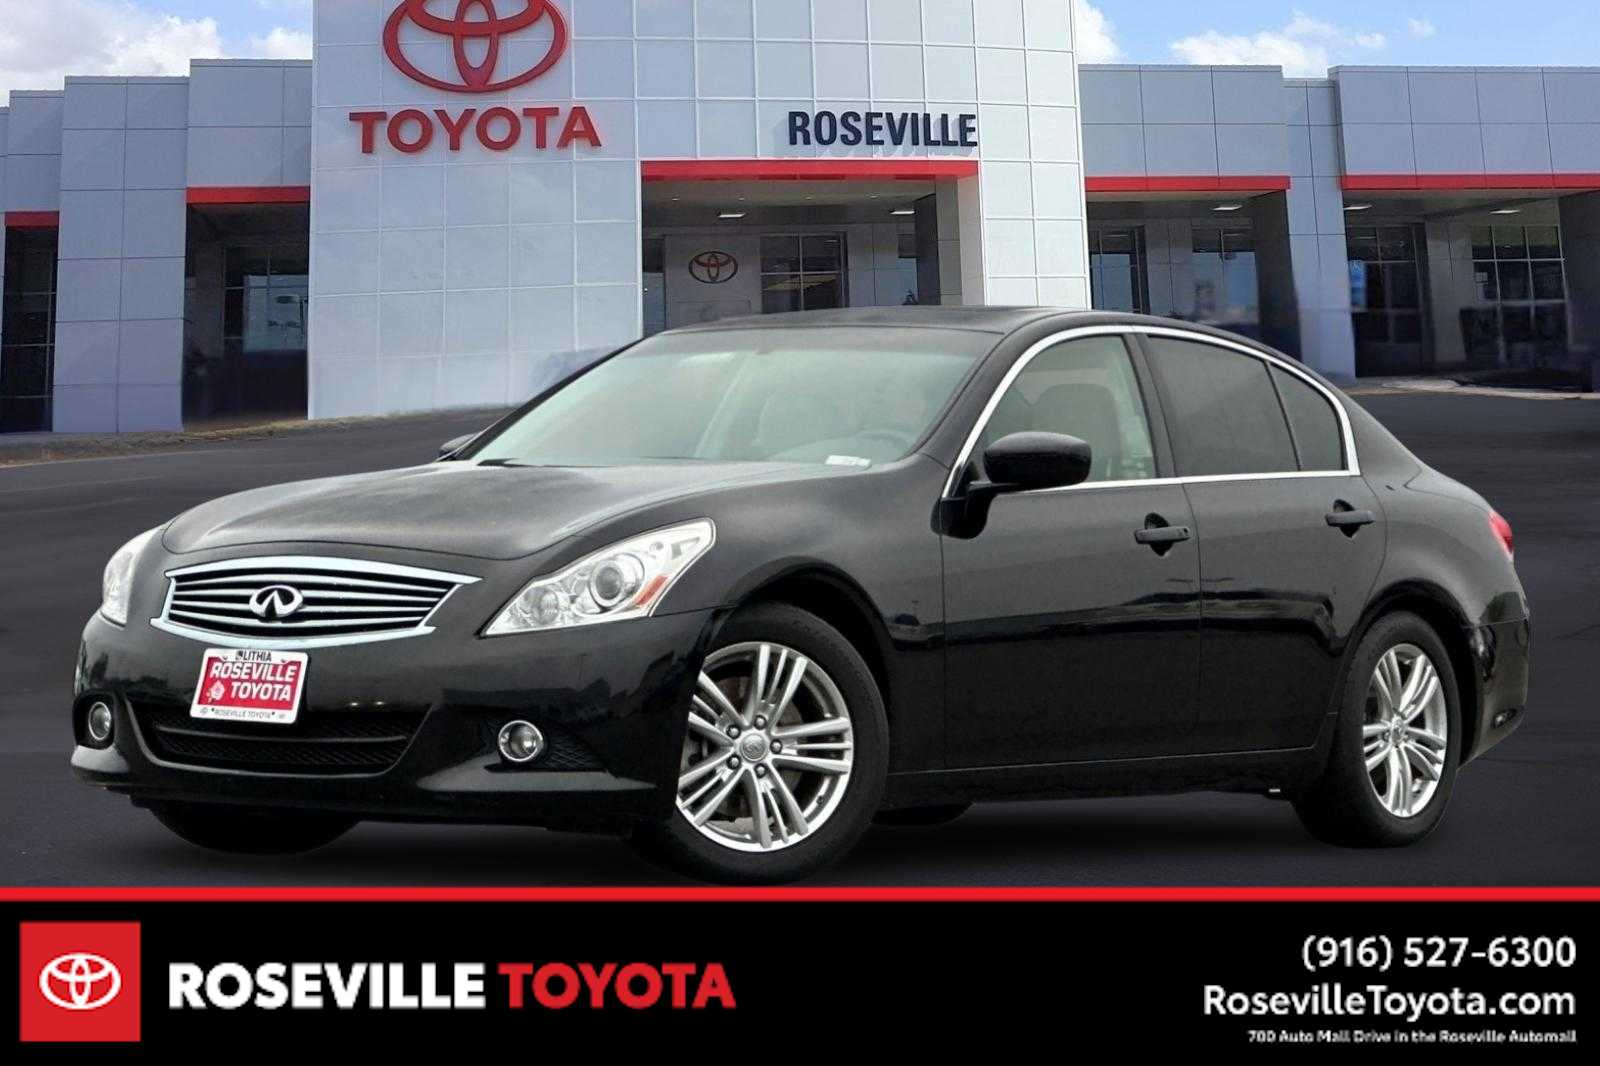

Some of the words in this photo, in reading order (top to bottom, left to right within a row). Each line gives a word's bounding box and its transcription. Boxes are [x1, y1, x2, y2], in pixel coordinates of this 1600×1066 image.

[349, 106, 602, 154] TOYOTA
[788, 111, 978, 147] ROSEVILLE
[242, 651, 272, 662] LITHIA
[210, 661, 298, 682] ROSEVILLE
[230, 682, 291, 701] TOYOTA
